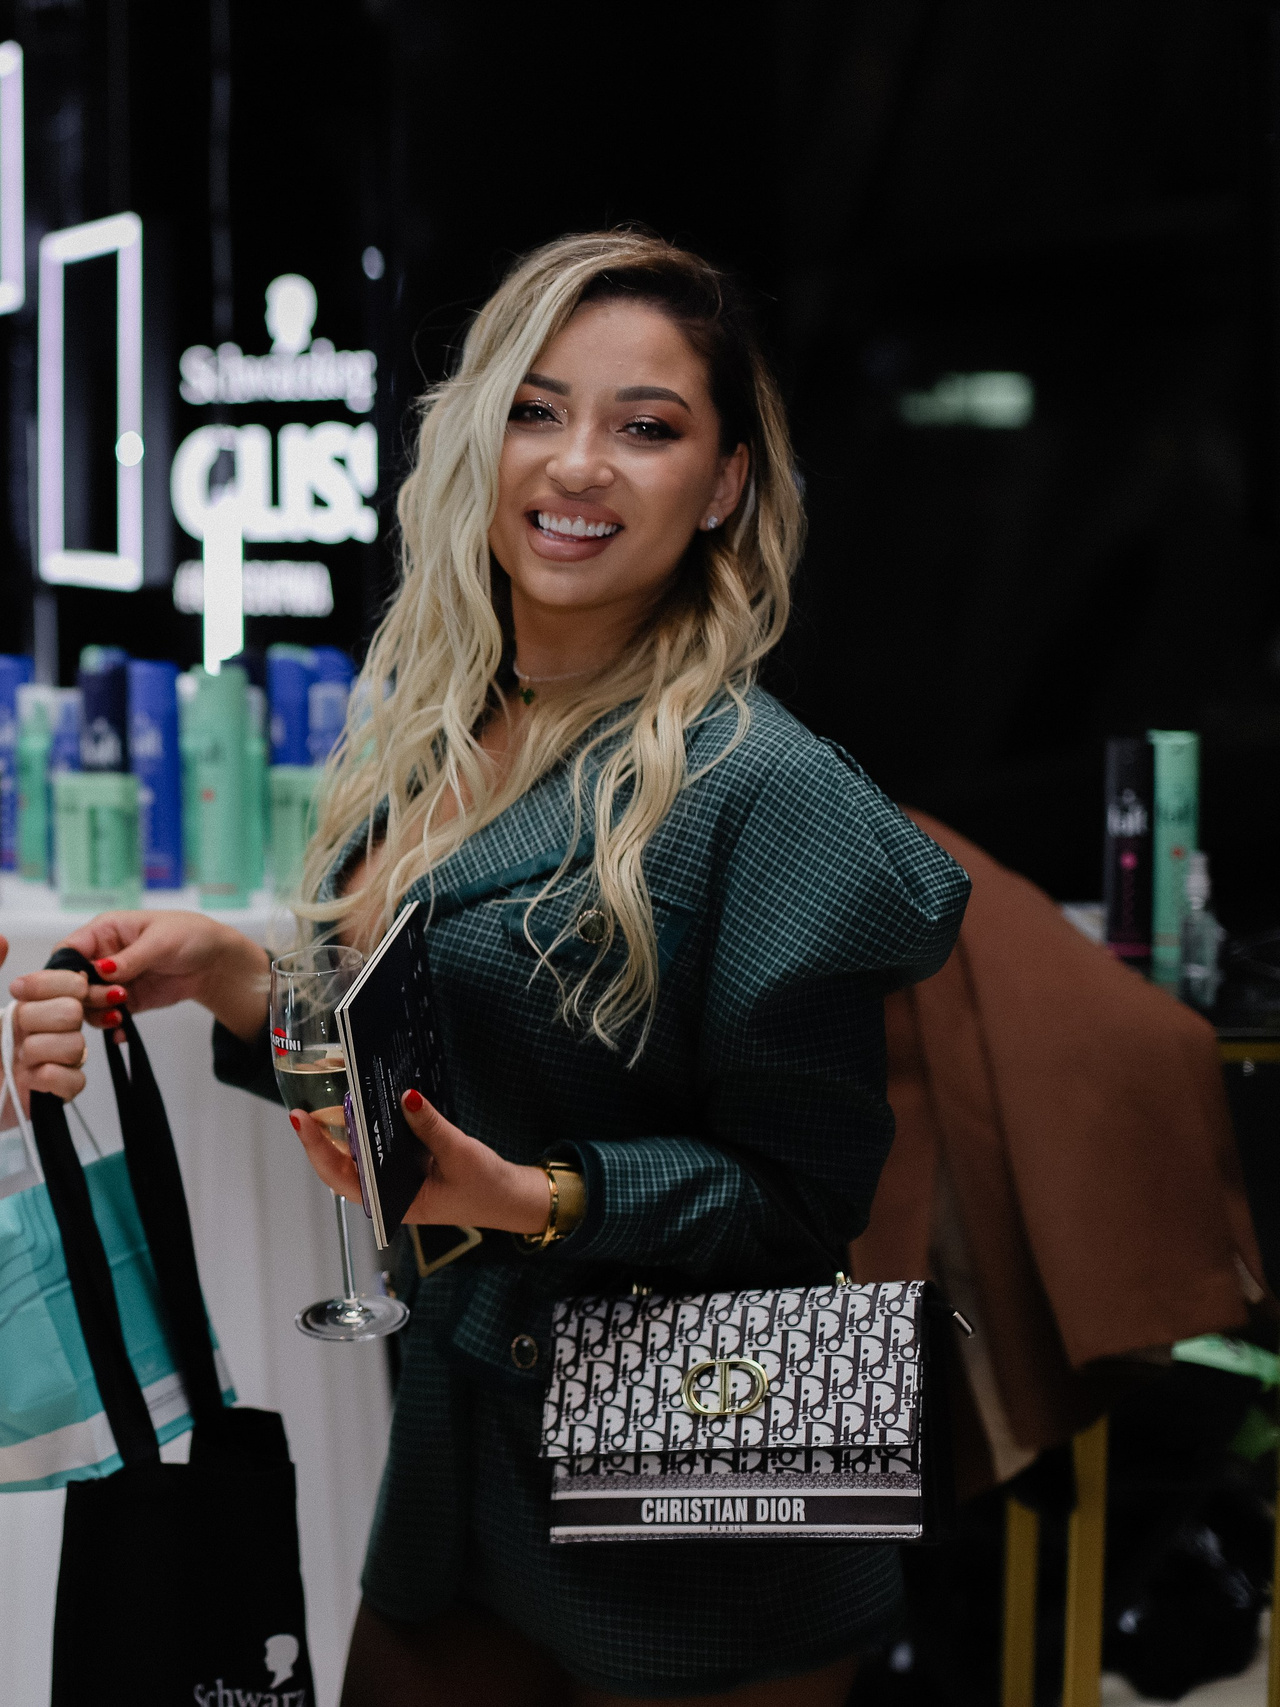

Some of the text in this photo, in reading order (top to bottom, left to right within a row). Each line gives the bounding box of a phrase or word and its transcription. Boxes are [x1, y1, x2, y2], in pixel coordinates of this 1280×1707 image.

[271, 1033, 302, 1052] ARTINI
[373, 1120, 384, 1166] VISA
[640, 1497, 807, 1523] CHRISTIAN DIOR
[709, 1525, 744, 1533] PARIS
